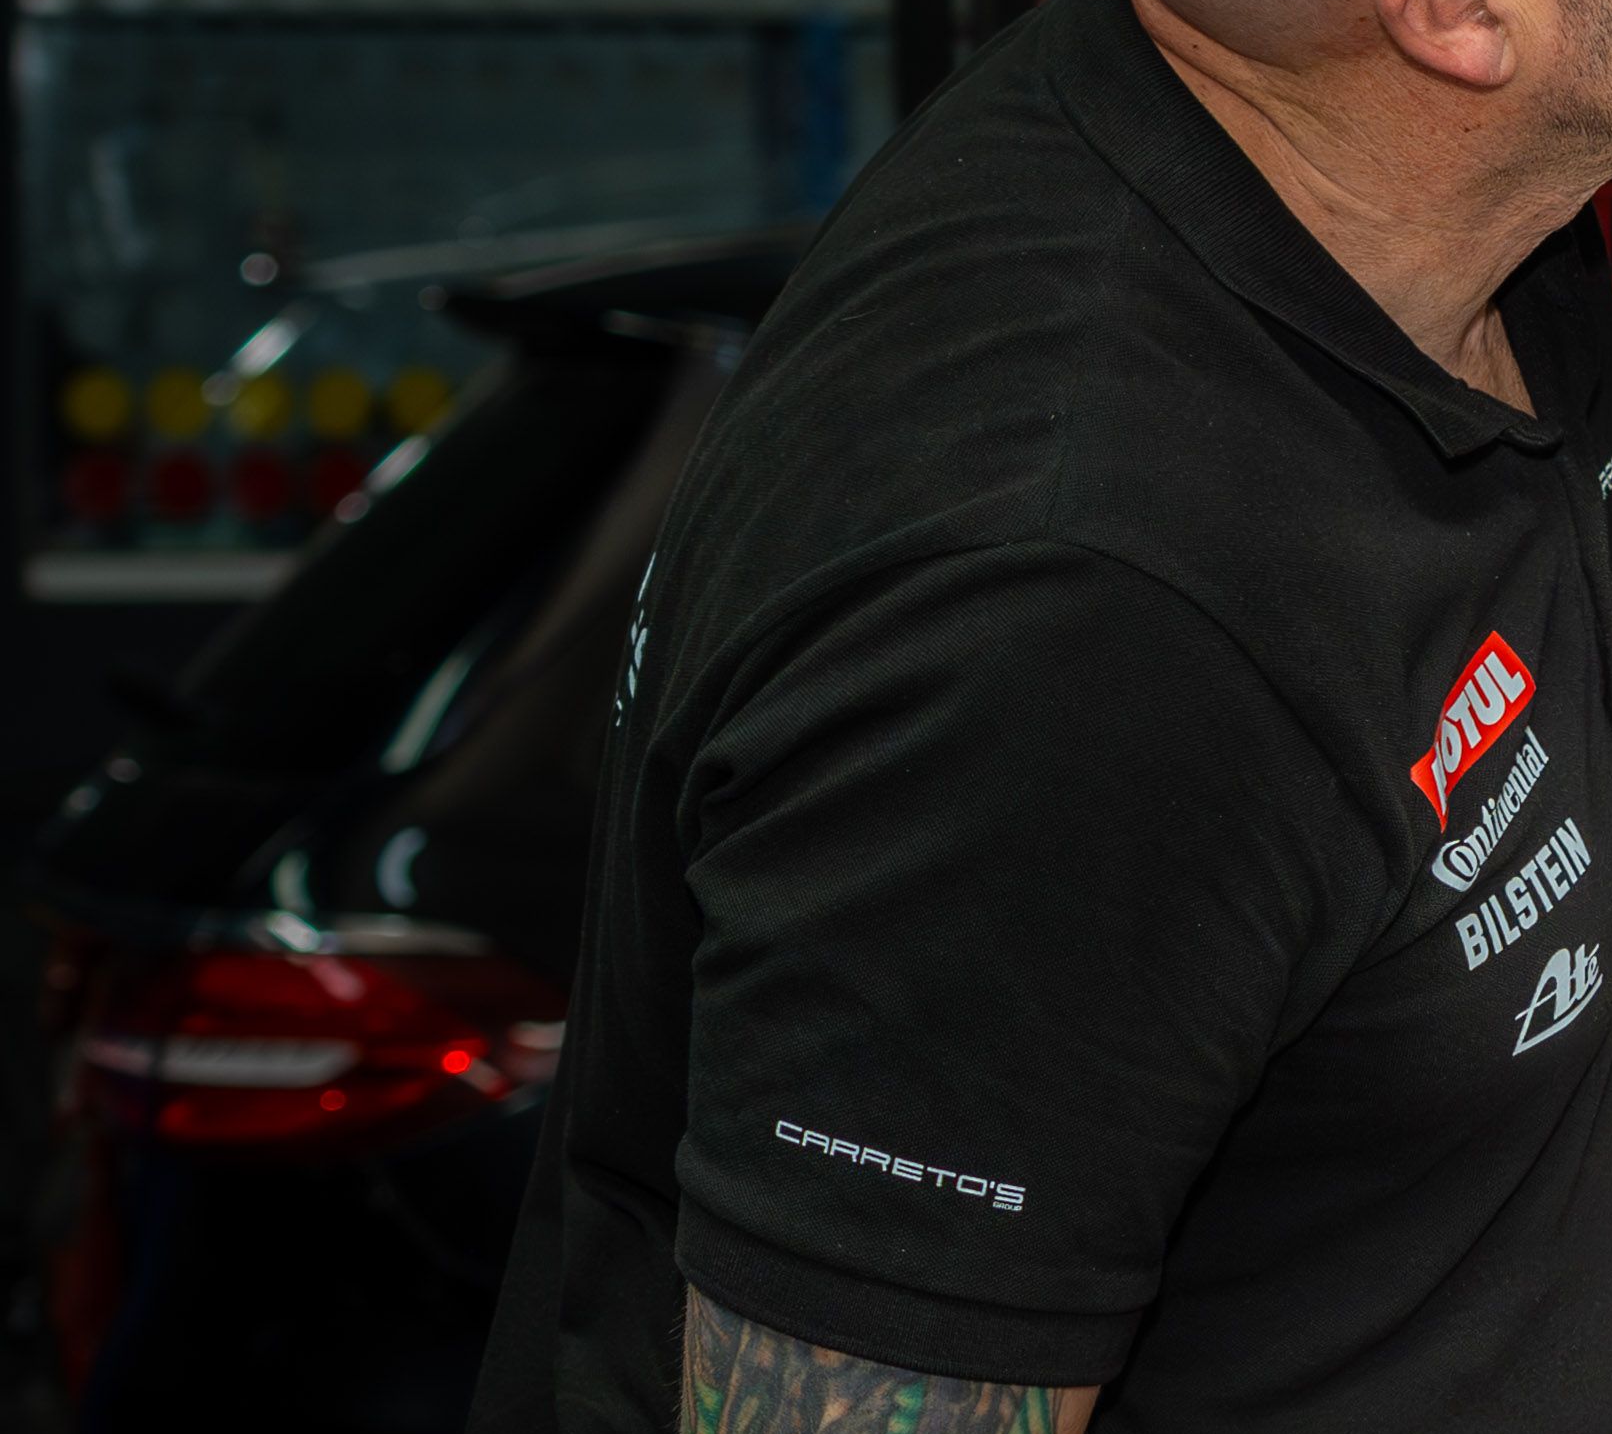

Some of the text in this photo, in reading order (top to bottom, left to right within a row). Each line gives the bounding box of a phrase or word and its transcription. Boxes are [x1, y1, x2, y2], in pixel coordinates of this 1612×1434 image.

[1432, 726, 1550, 892] Continental
[1455, 817, 1592, 971] BILSTEIN
[774, 1119, 1026, 1205] CARRETO'S
[992, 1200, 1023, 1213] GROUP
